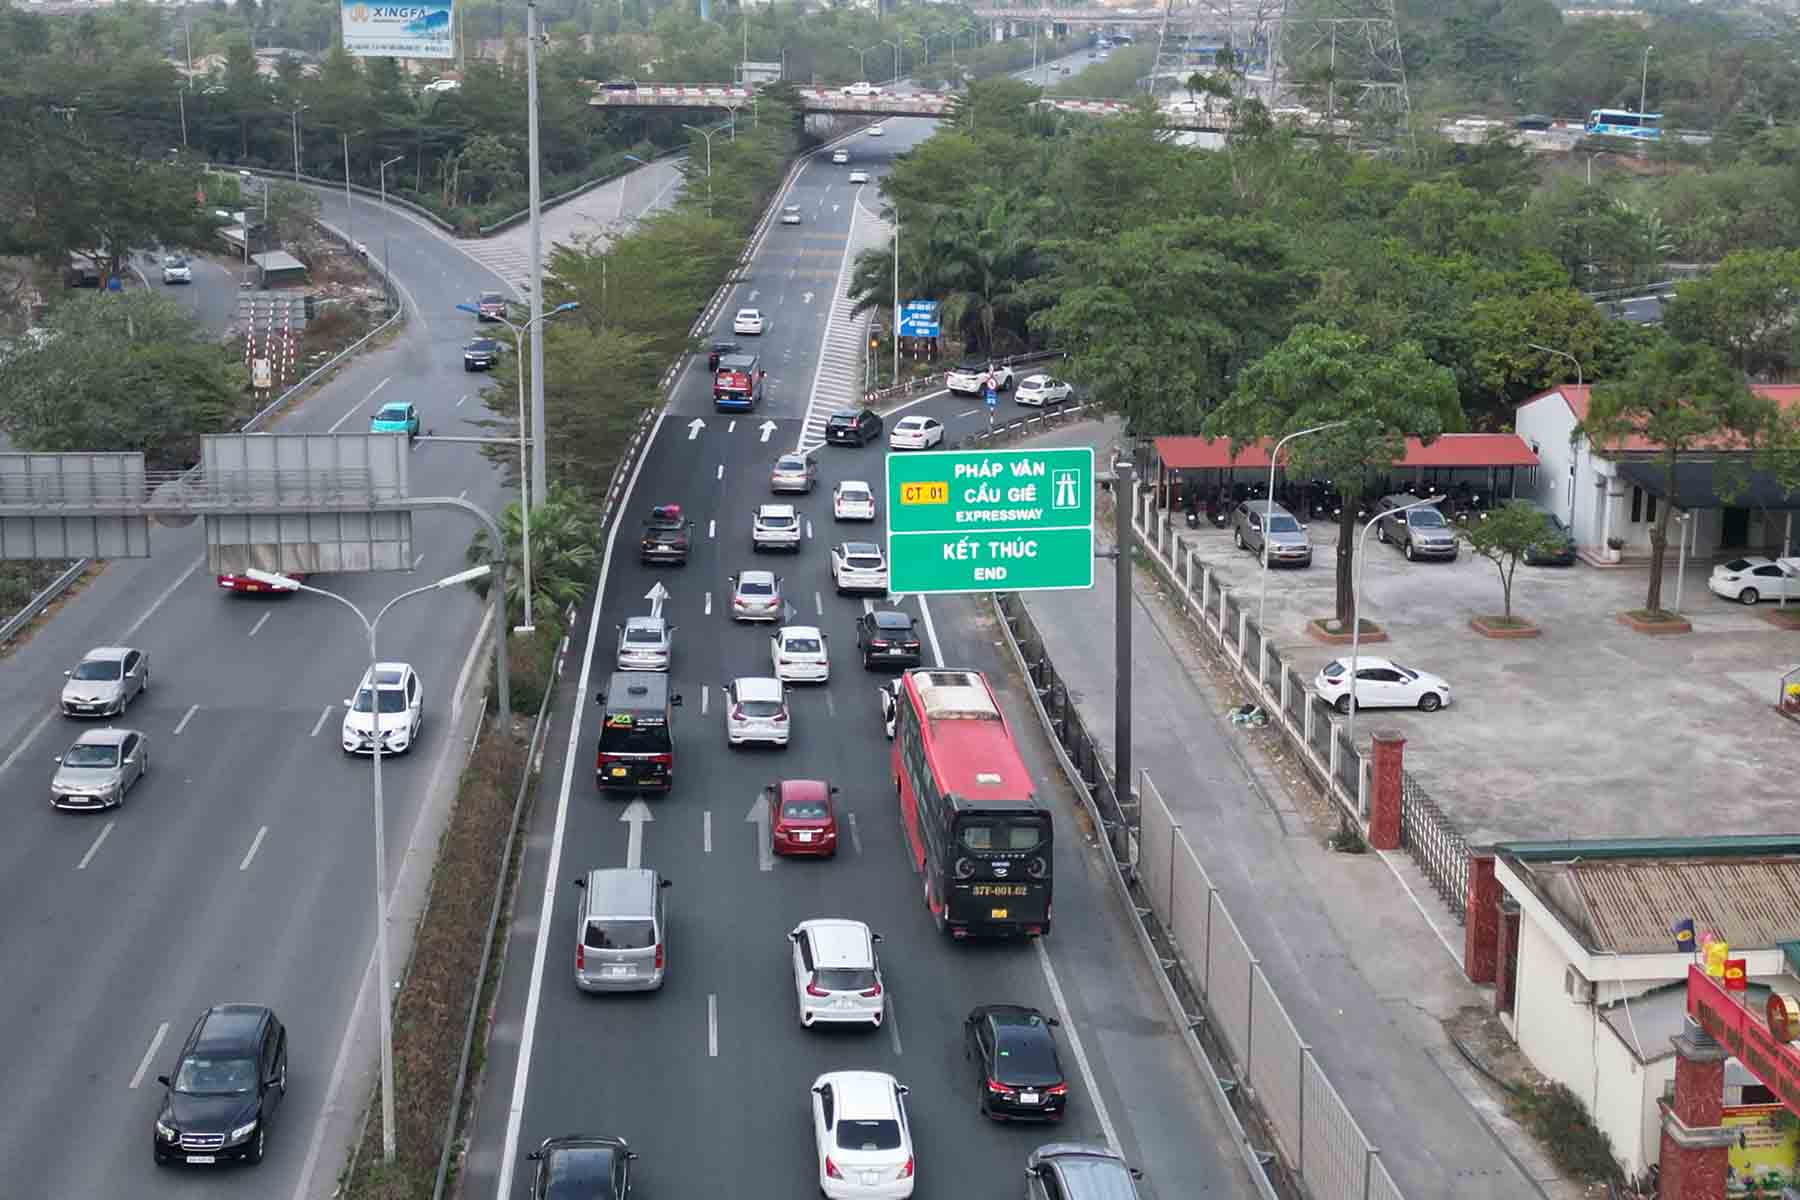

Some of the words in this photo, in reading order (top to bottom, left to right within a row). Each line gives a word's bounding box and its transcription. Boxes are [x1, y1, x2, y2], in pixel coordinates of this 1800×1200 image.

[373, 7, 426, 18] XINGFA
[954, 458, 1004, 479] PHÁP
[1009, 458, 1045, 477] VÂN
[906, 486, 922, 501] CT
[930, 486, 943, 500] 01
[955, 508, 1043, 523] EXPRESSWAY
[943, 535, 980, 560] KẾT
[988, 535, 1038, 559] THÚC
[973, 566, 1007, 580] END
